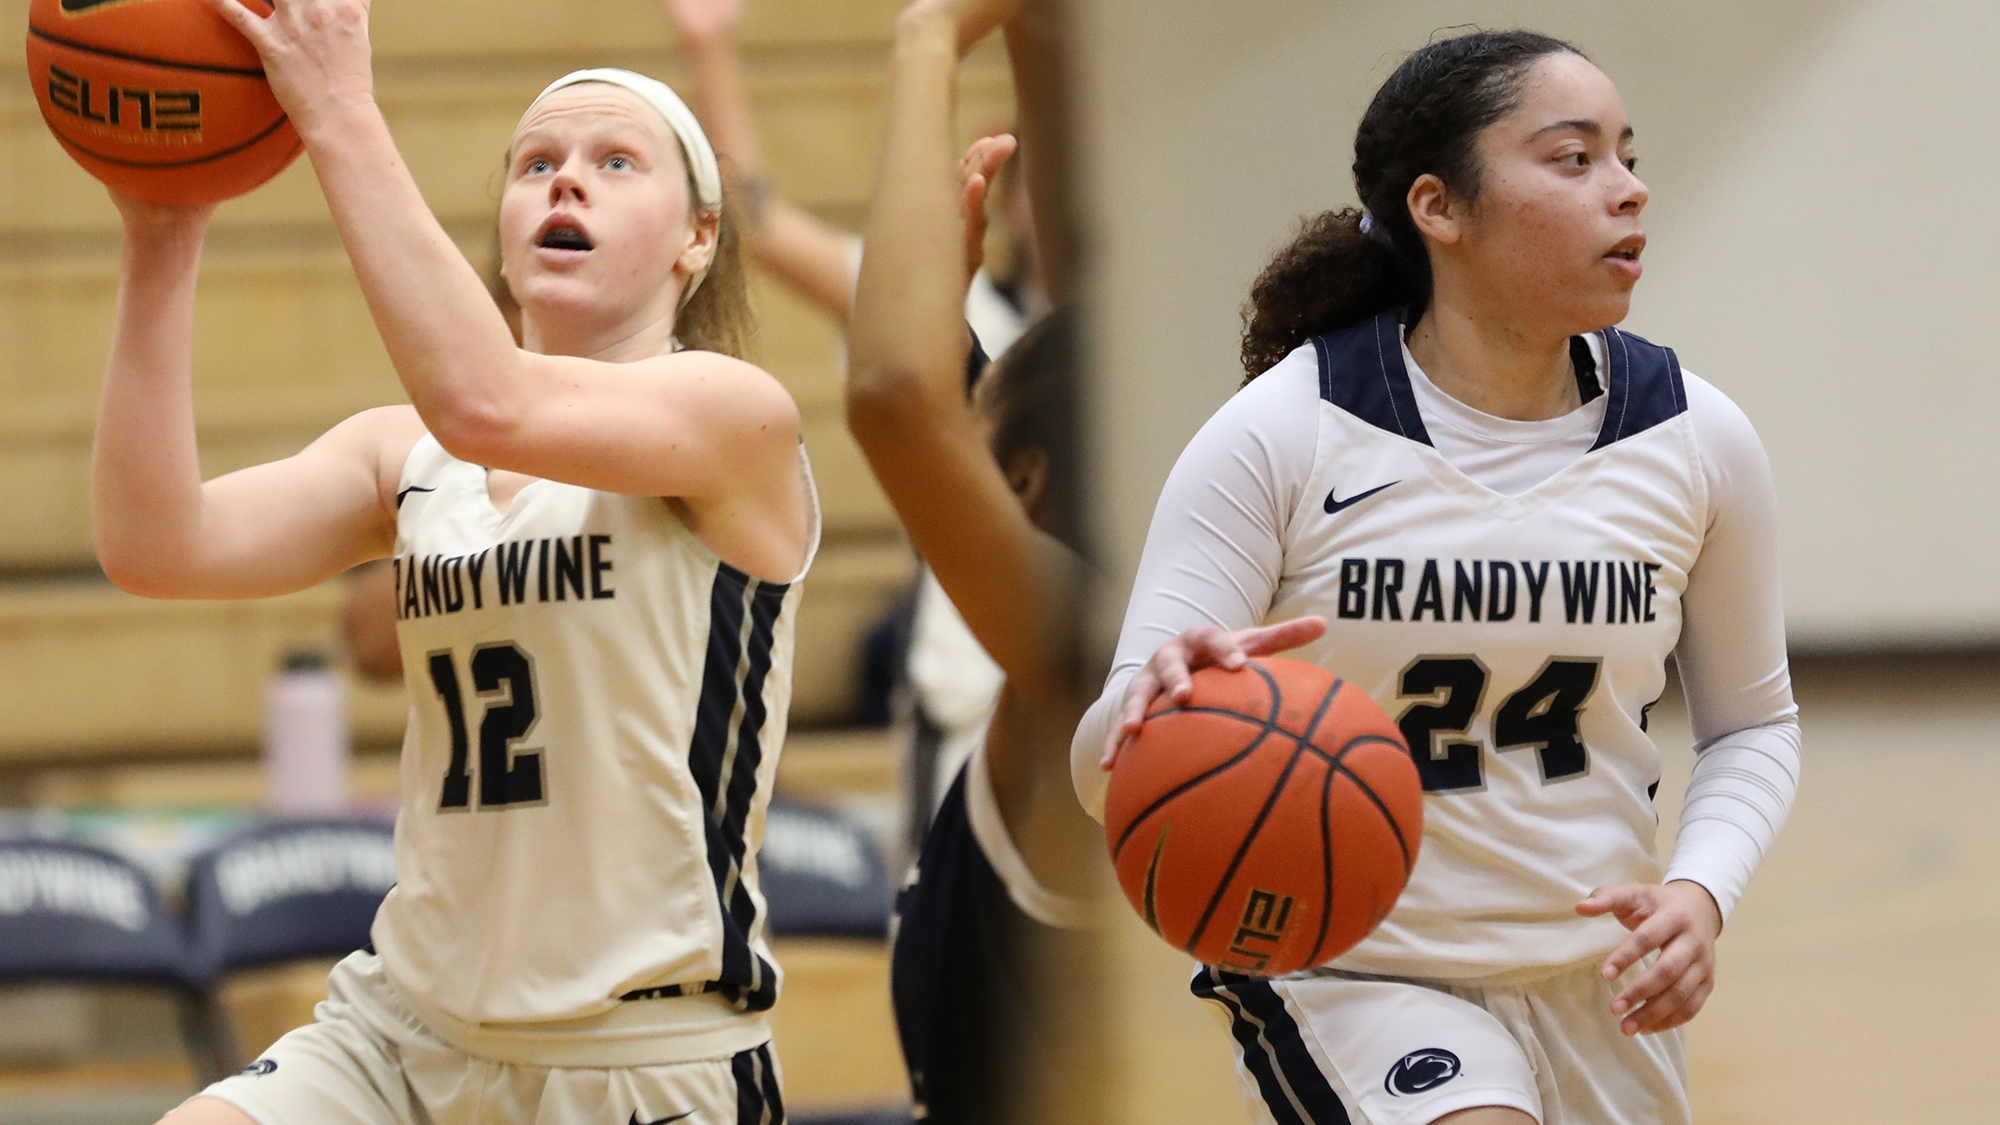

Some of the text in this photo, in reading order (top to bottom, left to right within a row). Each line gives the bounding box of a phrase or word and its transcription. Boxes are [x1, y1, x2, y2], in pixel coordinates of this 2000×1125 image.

[49, 63, 202, 132] ELITE
[394, 534, 616, 620] ANDYWINE
[1336, 557, 1663, 625] BRANDYWINE
[425, 638, 550, 816] 12
[1394, 653, 1604, 794] 24
